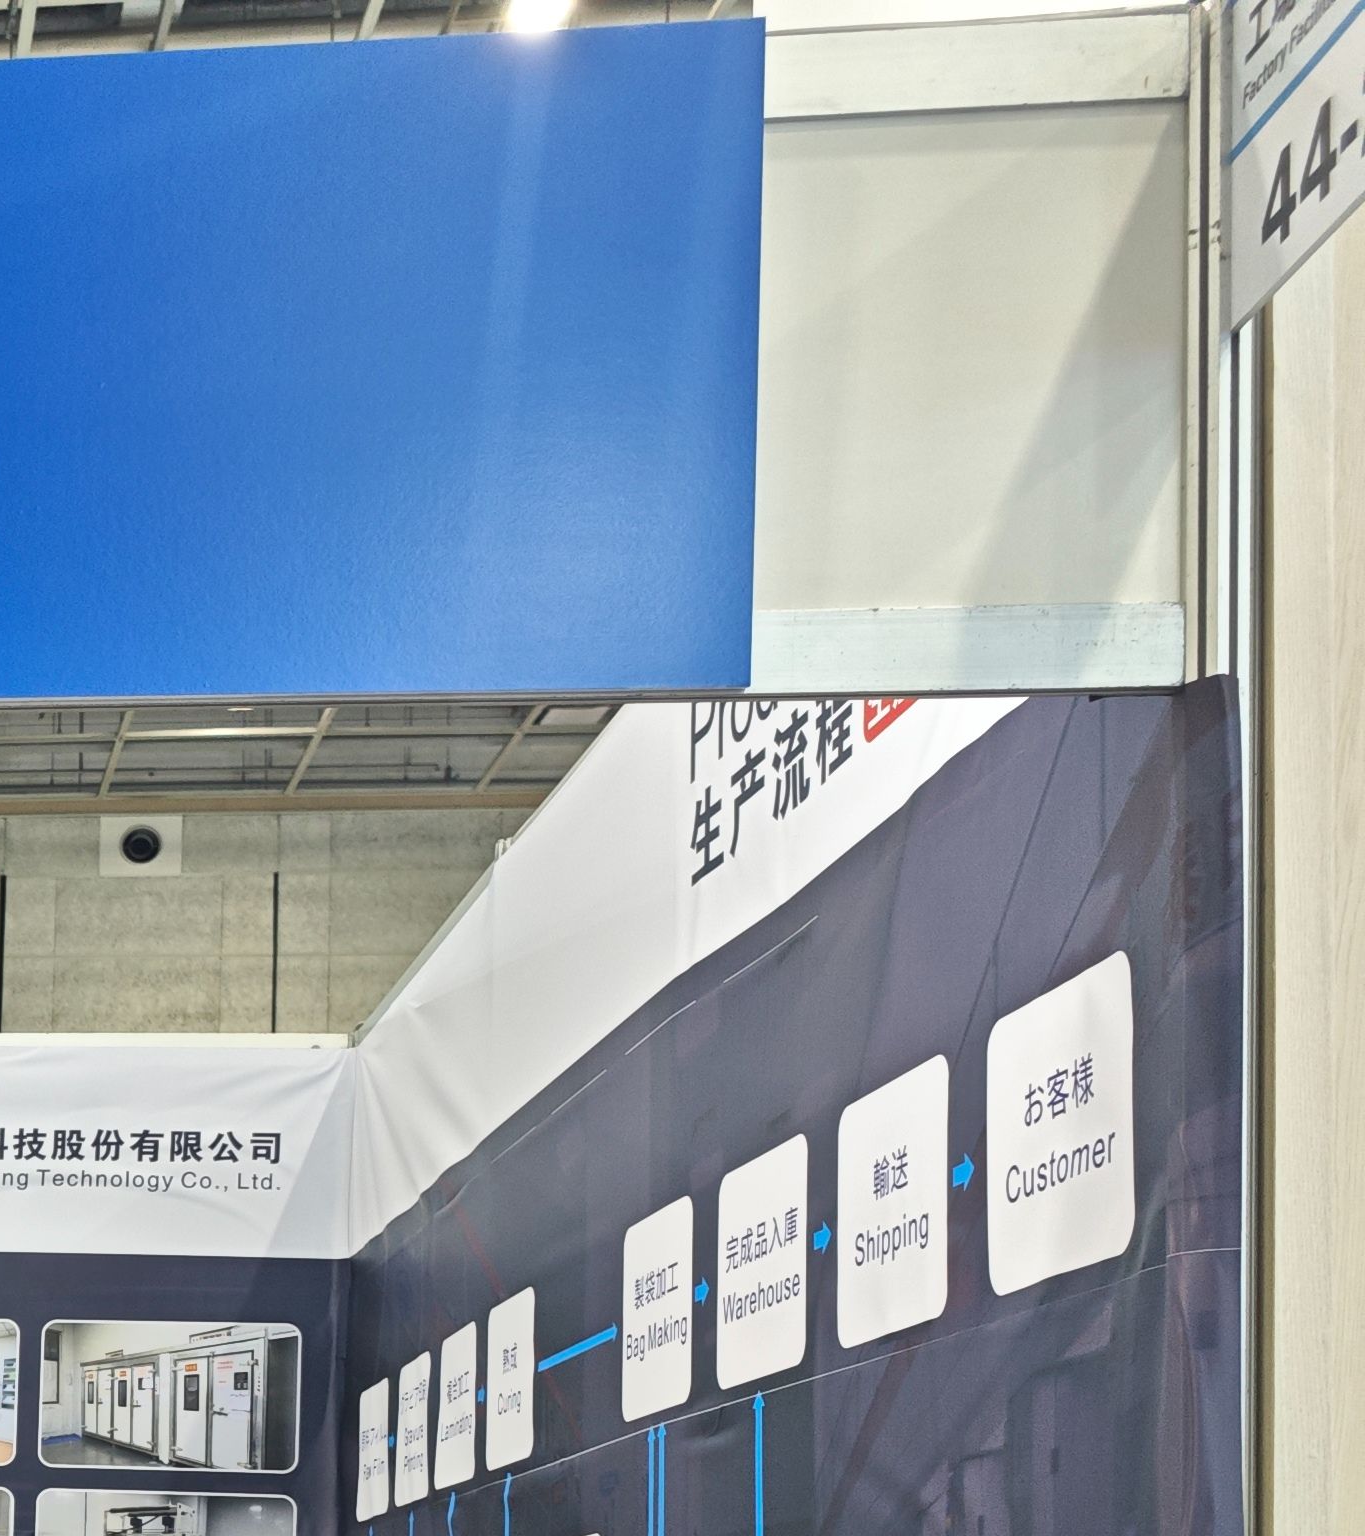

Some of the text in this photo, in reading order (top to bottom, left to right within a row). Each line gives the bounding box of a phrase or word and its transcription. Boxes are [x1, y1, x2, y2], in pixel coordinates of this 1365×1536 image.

[1261, 92, 1365, 246] 44-
[690, 700, 853, 888] 生产流程
[1023, 1052, 1094, 1128] お客様
[35, 1169, 173, 1194] Technology
[180, 1171, 228, 1194] Co.,
[236, 1172, 282, 1193] Ltd.
[873, 1145, 908, 1201] 輸送
[1005, 1131, 1117, 1204] Customer
[724, 1206, 800, 1272] 完成品入庫
[853, 1210, 930, 1268] Shipping
[633, 1261, 680, 1311] 製袋加工
[722, 1273, 801, 1325] Warehouse
[626, 1314, 688, 1362] Bag Making
